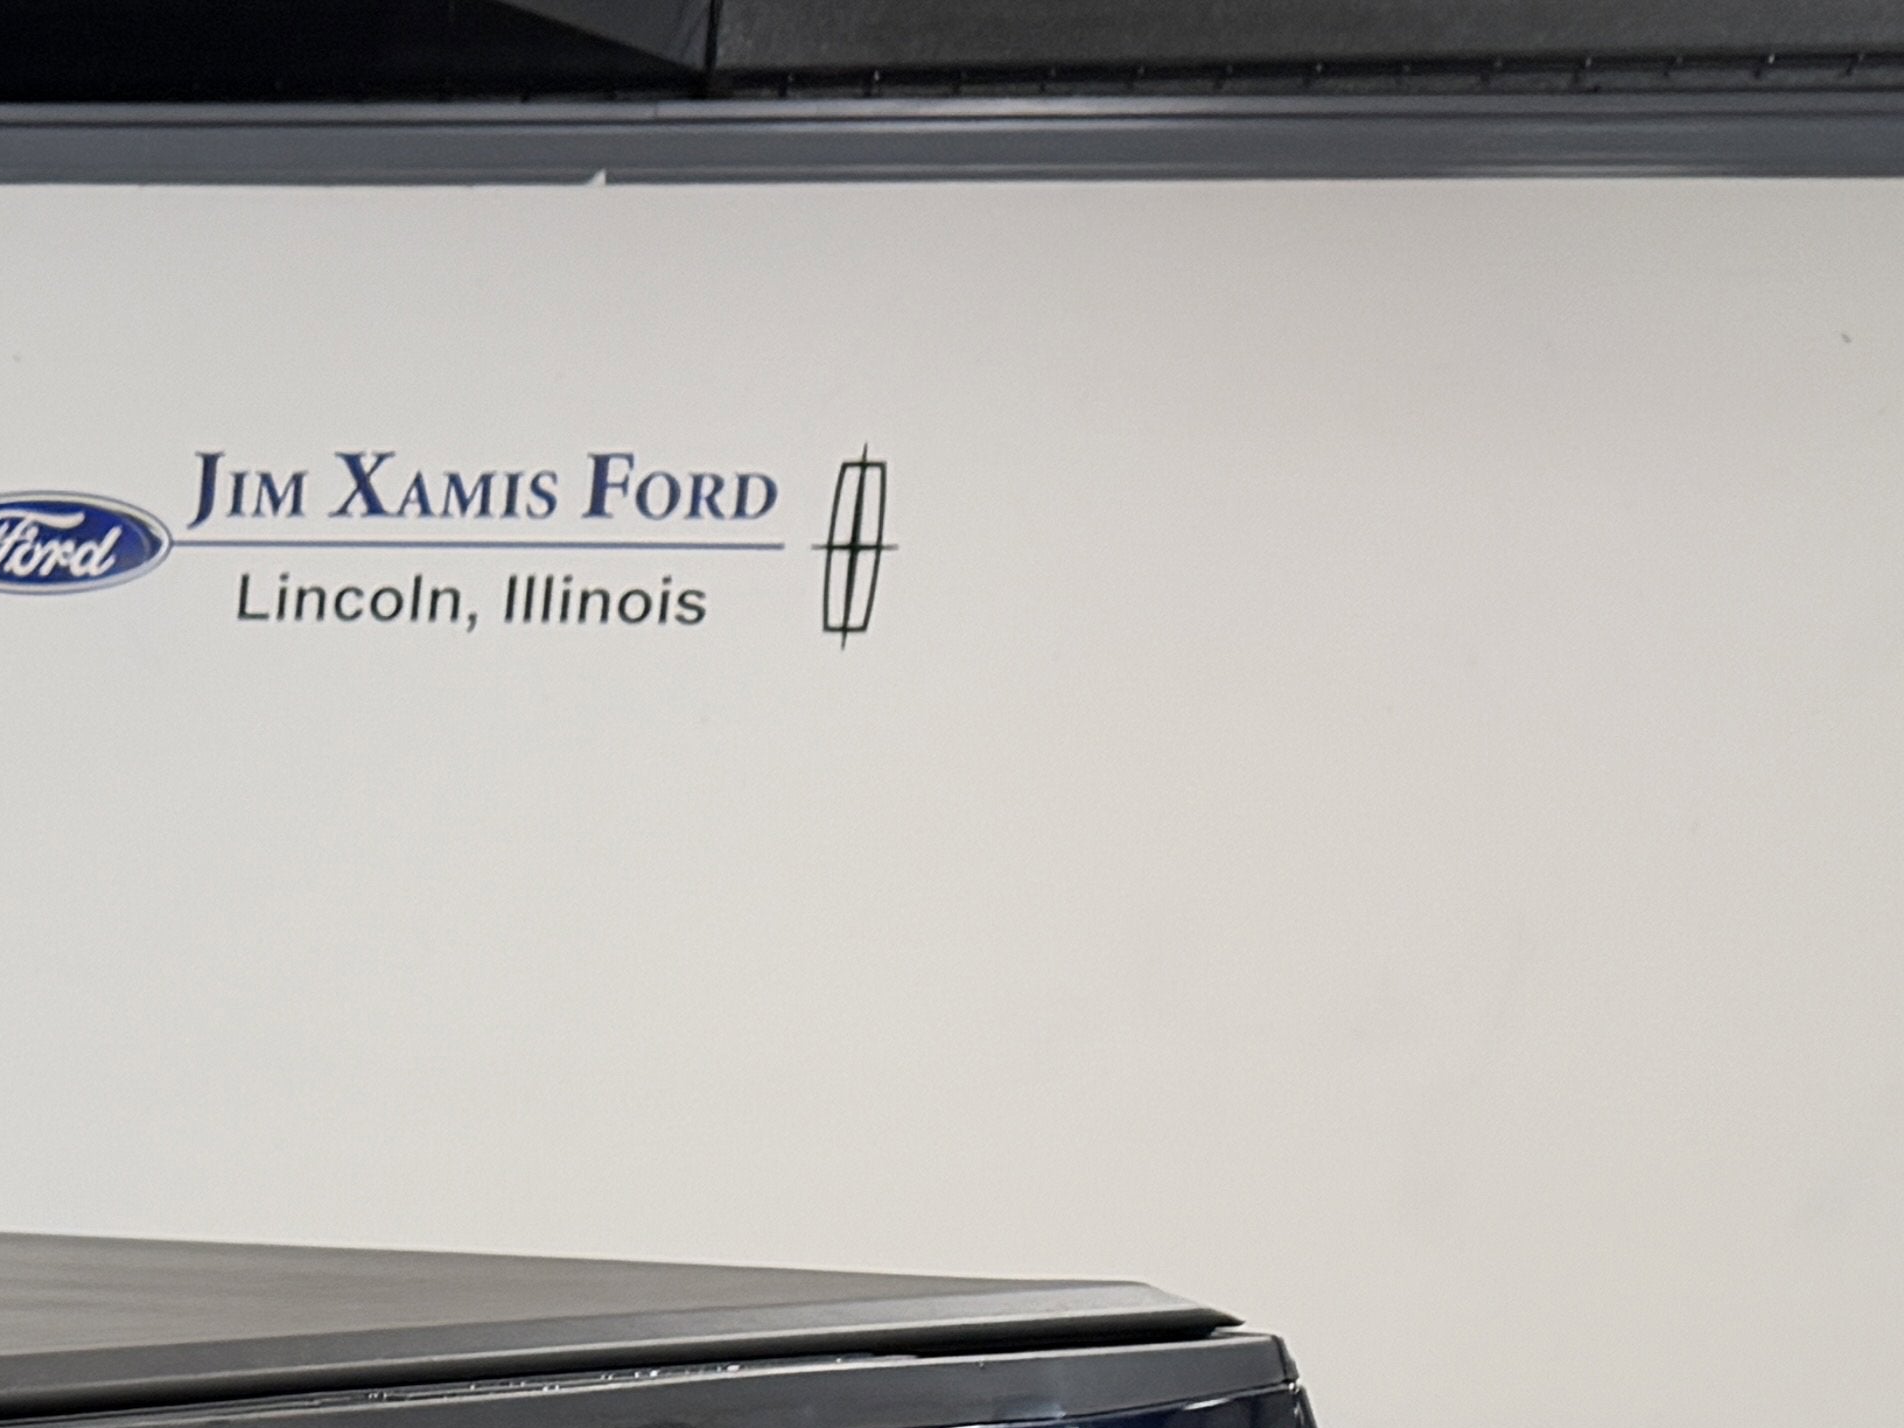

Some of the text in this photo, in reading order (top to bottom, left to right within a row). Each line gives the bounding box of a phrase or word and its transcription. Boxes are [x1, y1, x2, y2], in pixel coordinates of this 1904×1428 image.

[187, 451, 779, 530] JIM XAMIS FORD
[236, 573, 707, 632] Lincoln, Illinois
